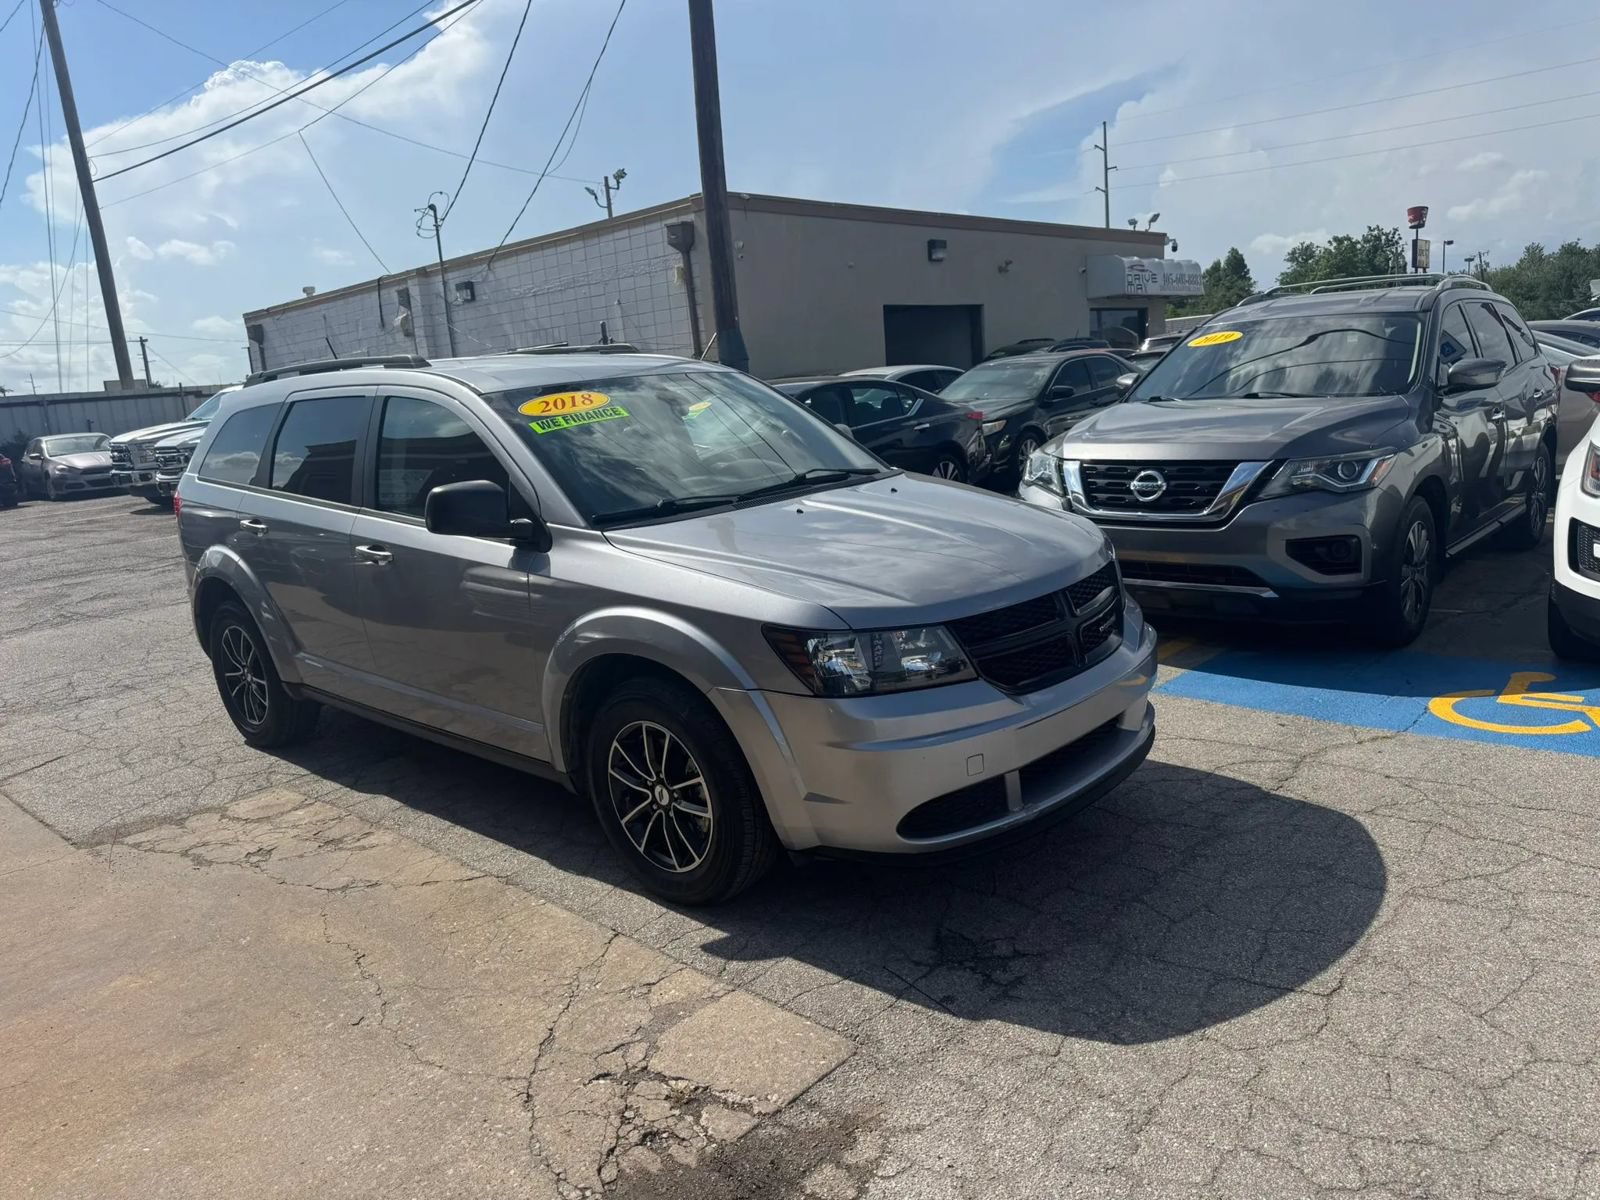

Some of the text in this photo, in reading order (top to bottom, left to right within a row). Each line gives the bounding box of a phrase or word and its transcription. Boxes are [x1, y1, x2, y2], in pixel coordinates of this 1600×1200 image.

[1127, 274, 1158, 284] DRIVE
[539, 393, 594, 414] 2018
[536, 407, 622, 431] WE FINANCE
